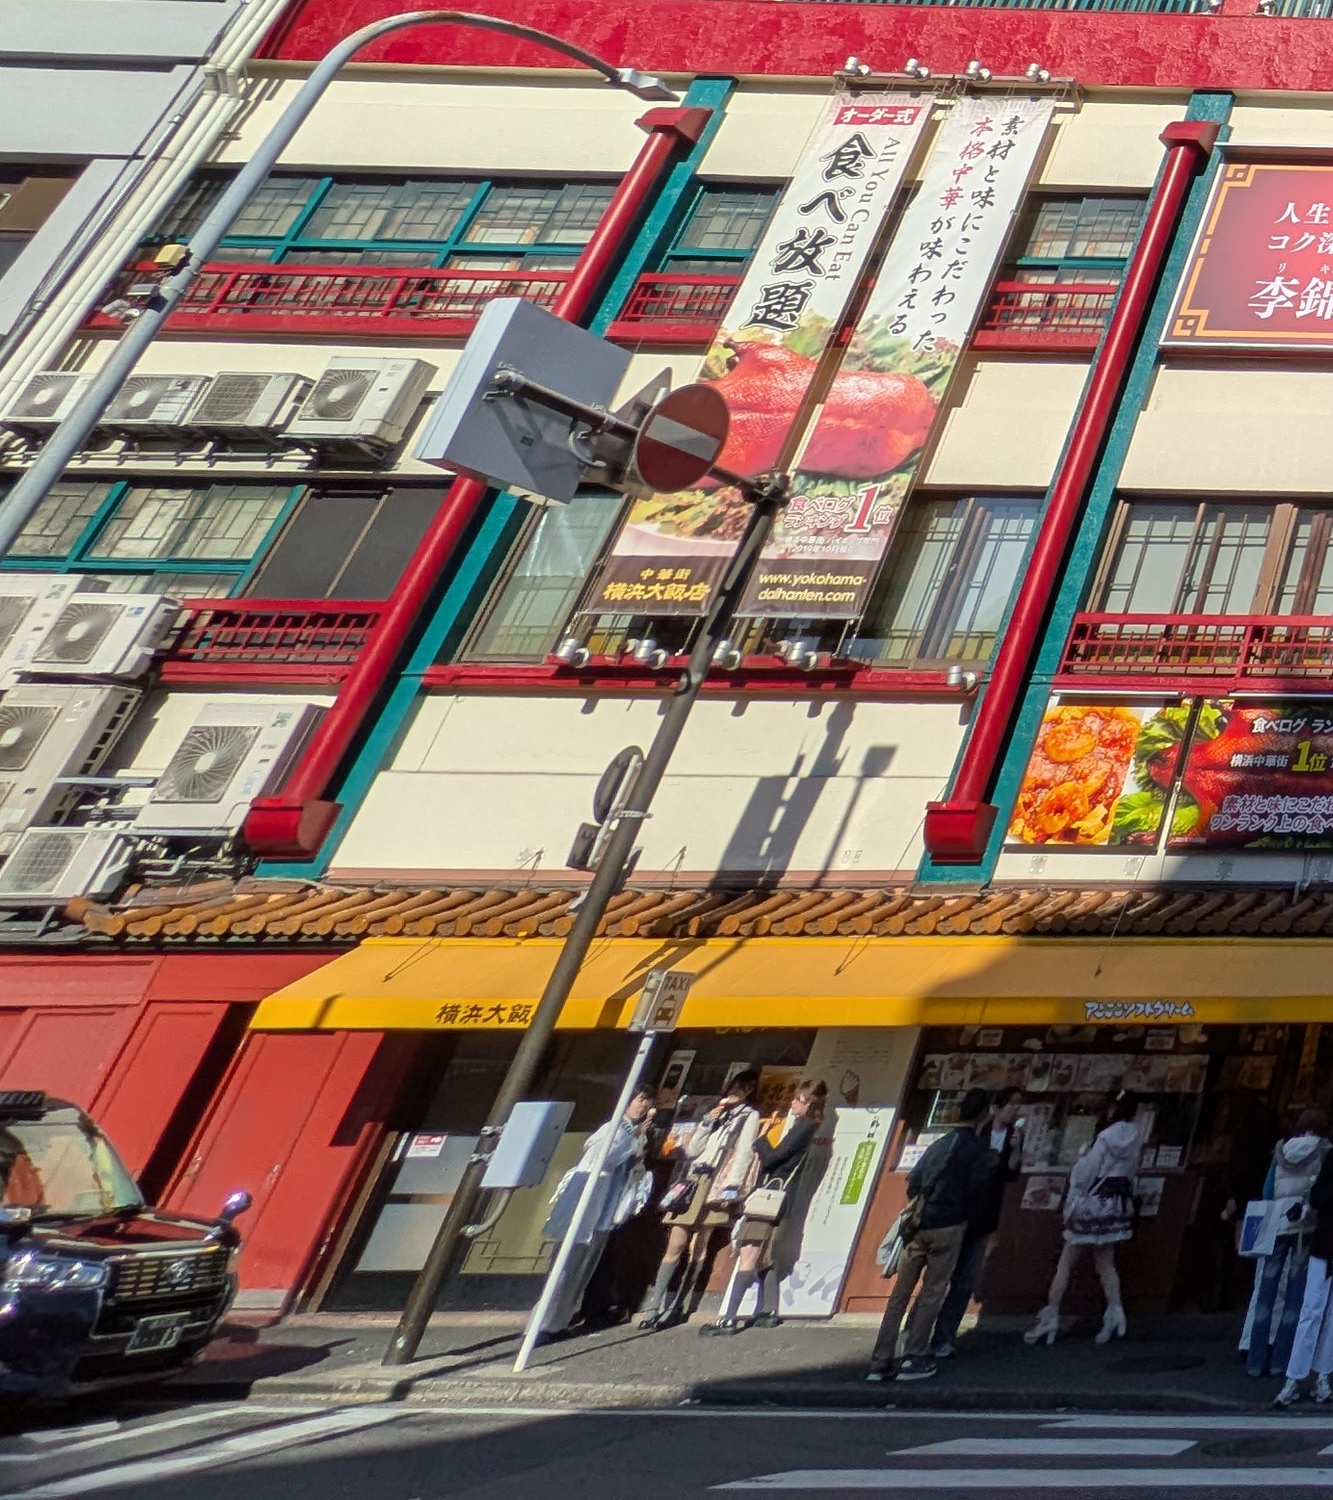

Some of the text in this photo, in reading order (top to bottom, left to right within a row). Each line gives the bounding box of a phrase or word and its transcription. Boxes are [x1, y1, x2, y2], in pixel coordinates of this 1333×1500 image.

[840, 106, 916, 127] オーダー式
[827, 136, 902, 282] All You Can Eat
[741, 131, 877, 331] 食べ放題
[887, 116, 994, 336] 本格中華が味わえる
[914, 115, 1027, 352] 素材と味にこだわった
[640, 567, 692, 581] 中華街
[758, 572, 868, 588] www.yokohama-
[602, 581, 712, 602] 横浜大飯店
[758, 587, 856, 603] daihanten.com
[1251, 717, 1307, 734] 食べログ
[1229, 753, 1289, 769] 横浜中華街
[1291, 739, 1329, 773] 1位
[663, 975, 691, 991] TAXI
[435, 1002, 536, 1025] 横浜大飯
